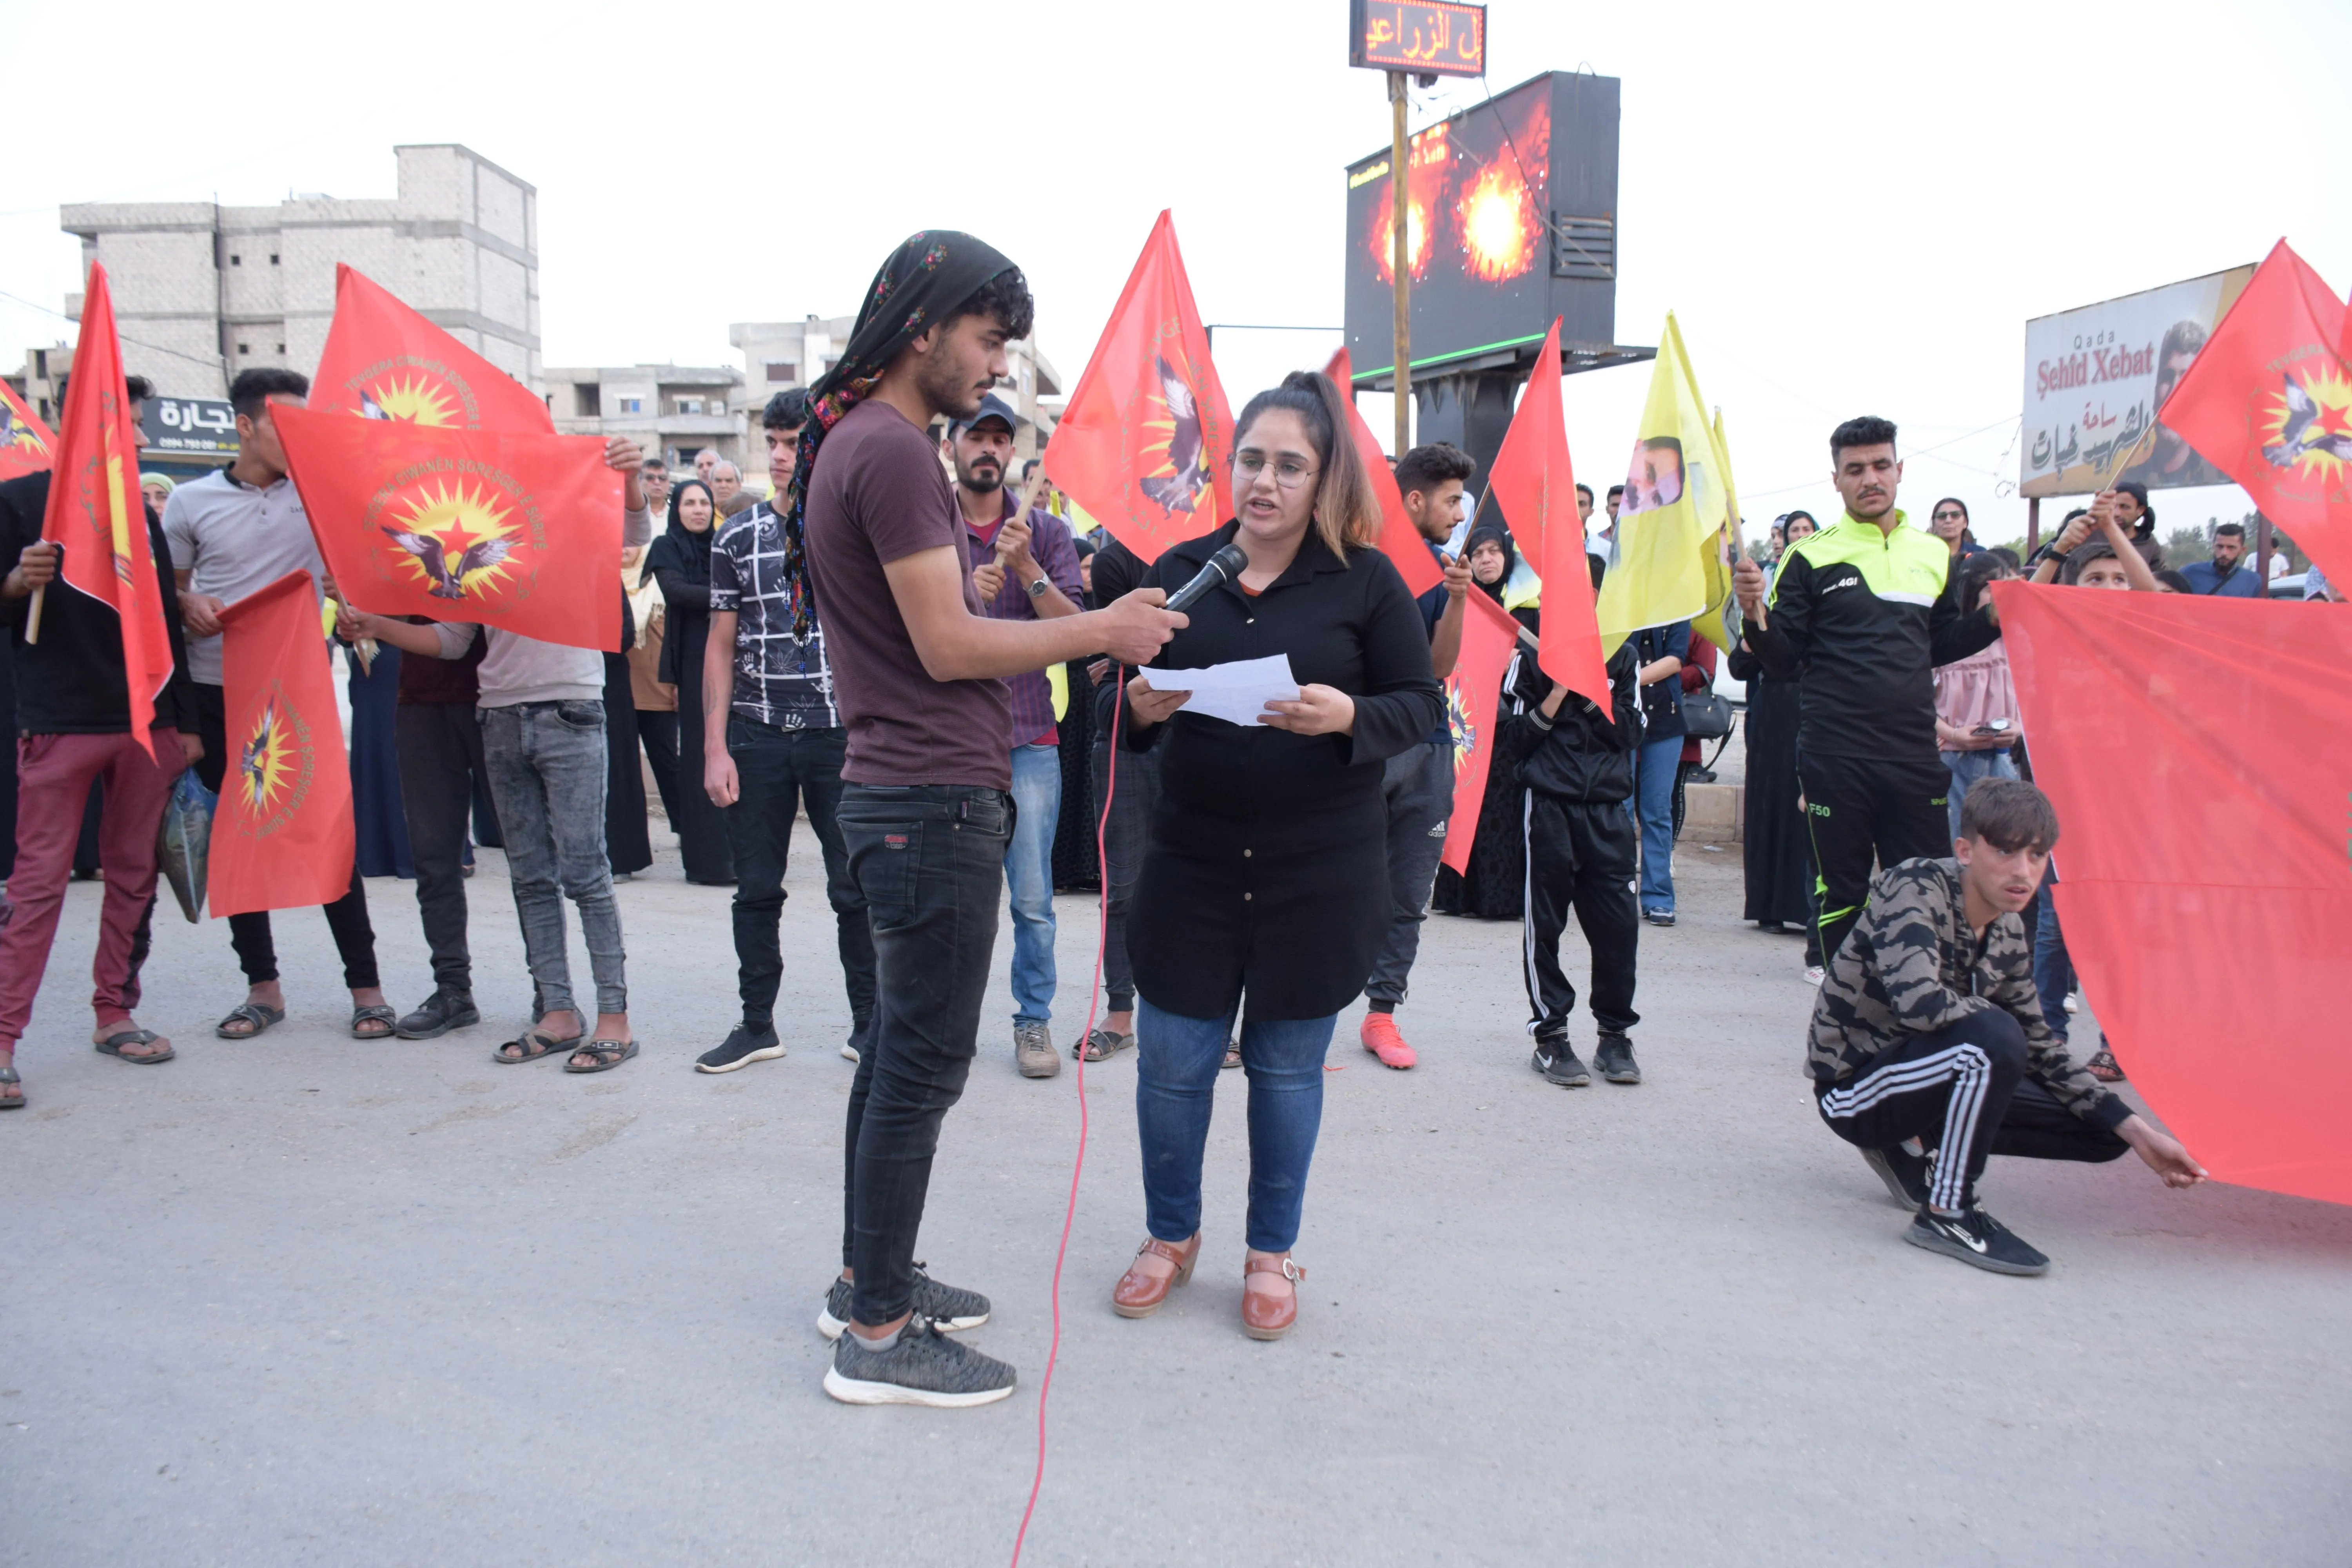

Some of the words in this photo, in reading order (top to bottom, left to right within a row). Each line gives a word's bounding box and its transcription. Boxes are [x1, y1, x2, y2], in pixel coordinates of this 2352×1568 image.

[2074, 330, 2115, 349] Qada
[2036, 350, 2088, 401] Şehîd
[2091, 341, 2154, 384] Xebat
[395, 455, 454, 486] CIWANÊN
[457, 458, 524, 498] ŞOREŞGER
[362, 481, 398, 532] TEVGERA
[519, 494, 534, 506] Ê
[525, 505, 548, 550] SÛRIYÊ
[288, 746, 315, 809] ŞOREŞGER
[1809, 803, 1830, 817] F50
